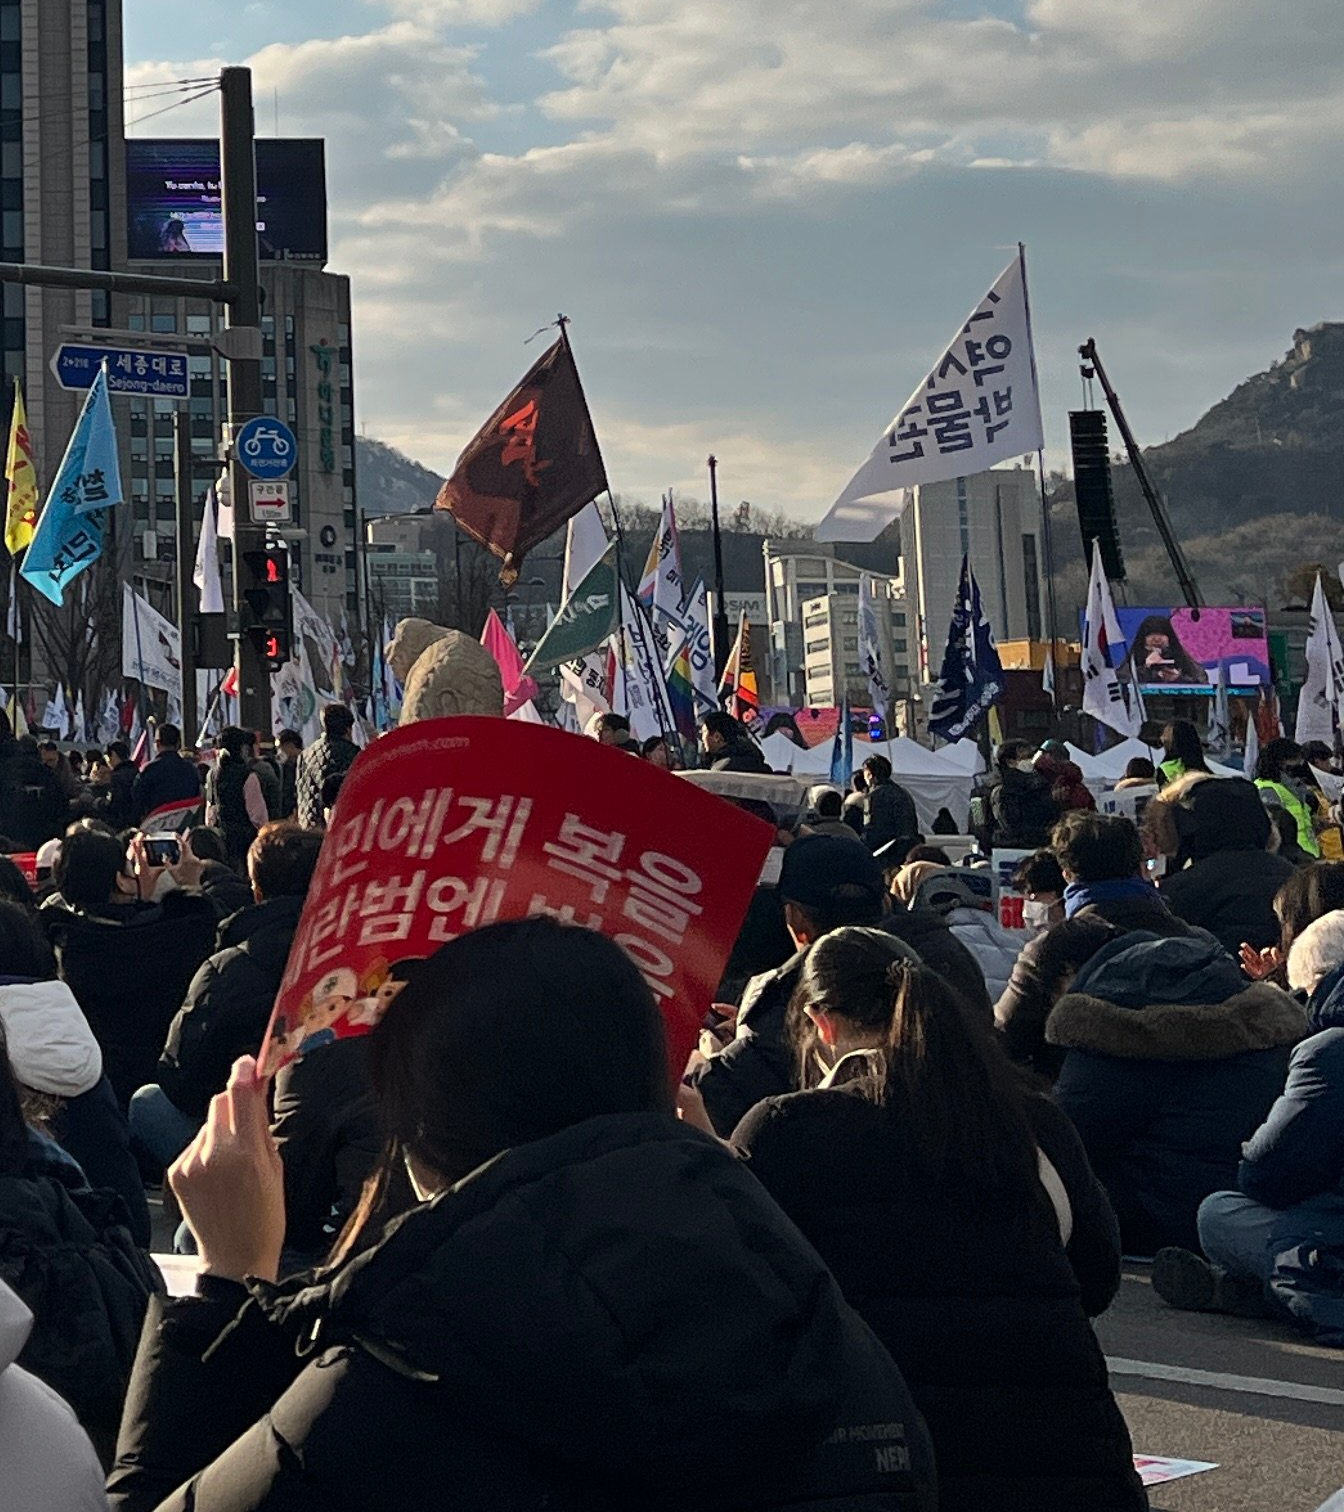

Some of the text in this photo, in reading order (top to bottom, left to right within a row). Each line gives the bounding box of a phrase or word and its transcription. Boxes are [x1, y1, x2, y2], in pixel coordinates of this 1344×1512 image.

[116, 354, 184, 376] 세종대로
[109, 375, 185, 393] Sejong-daero
[326, 787, 704, 945] 민에게 복을
